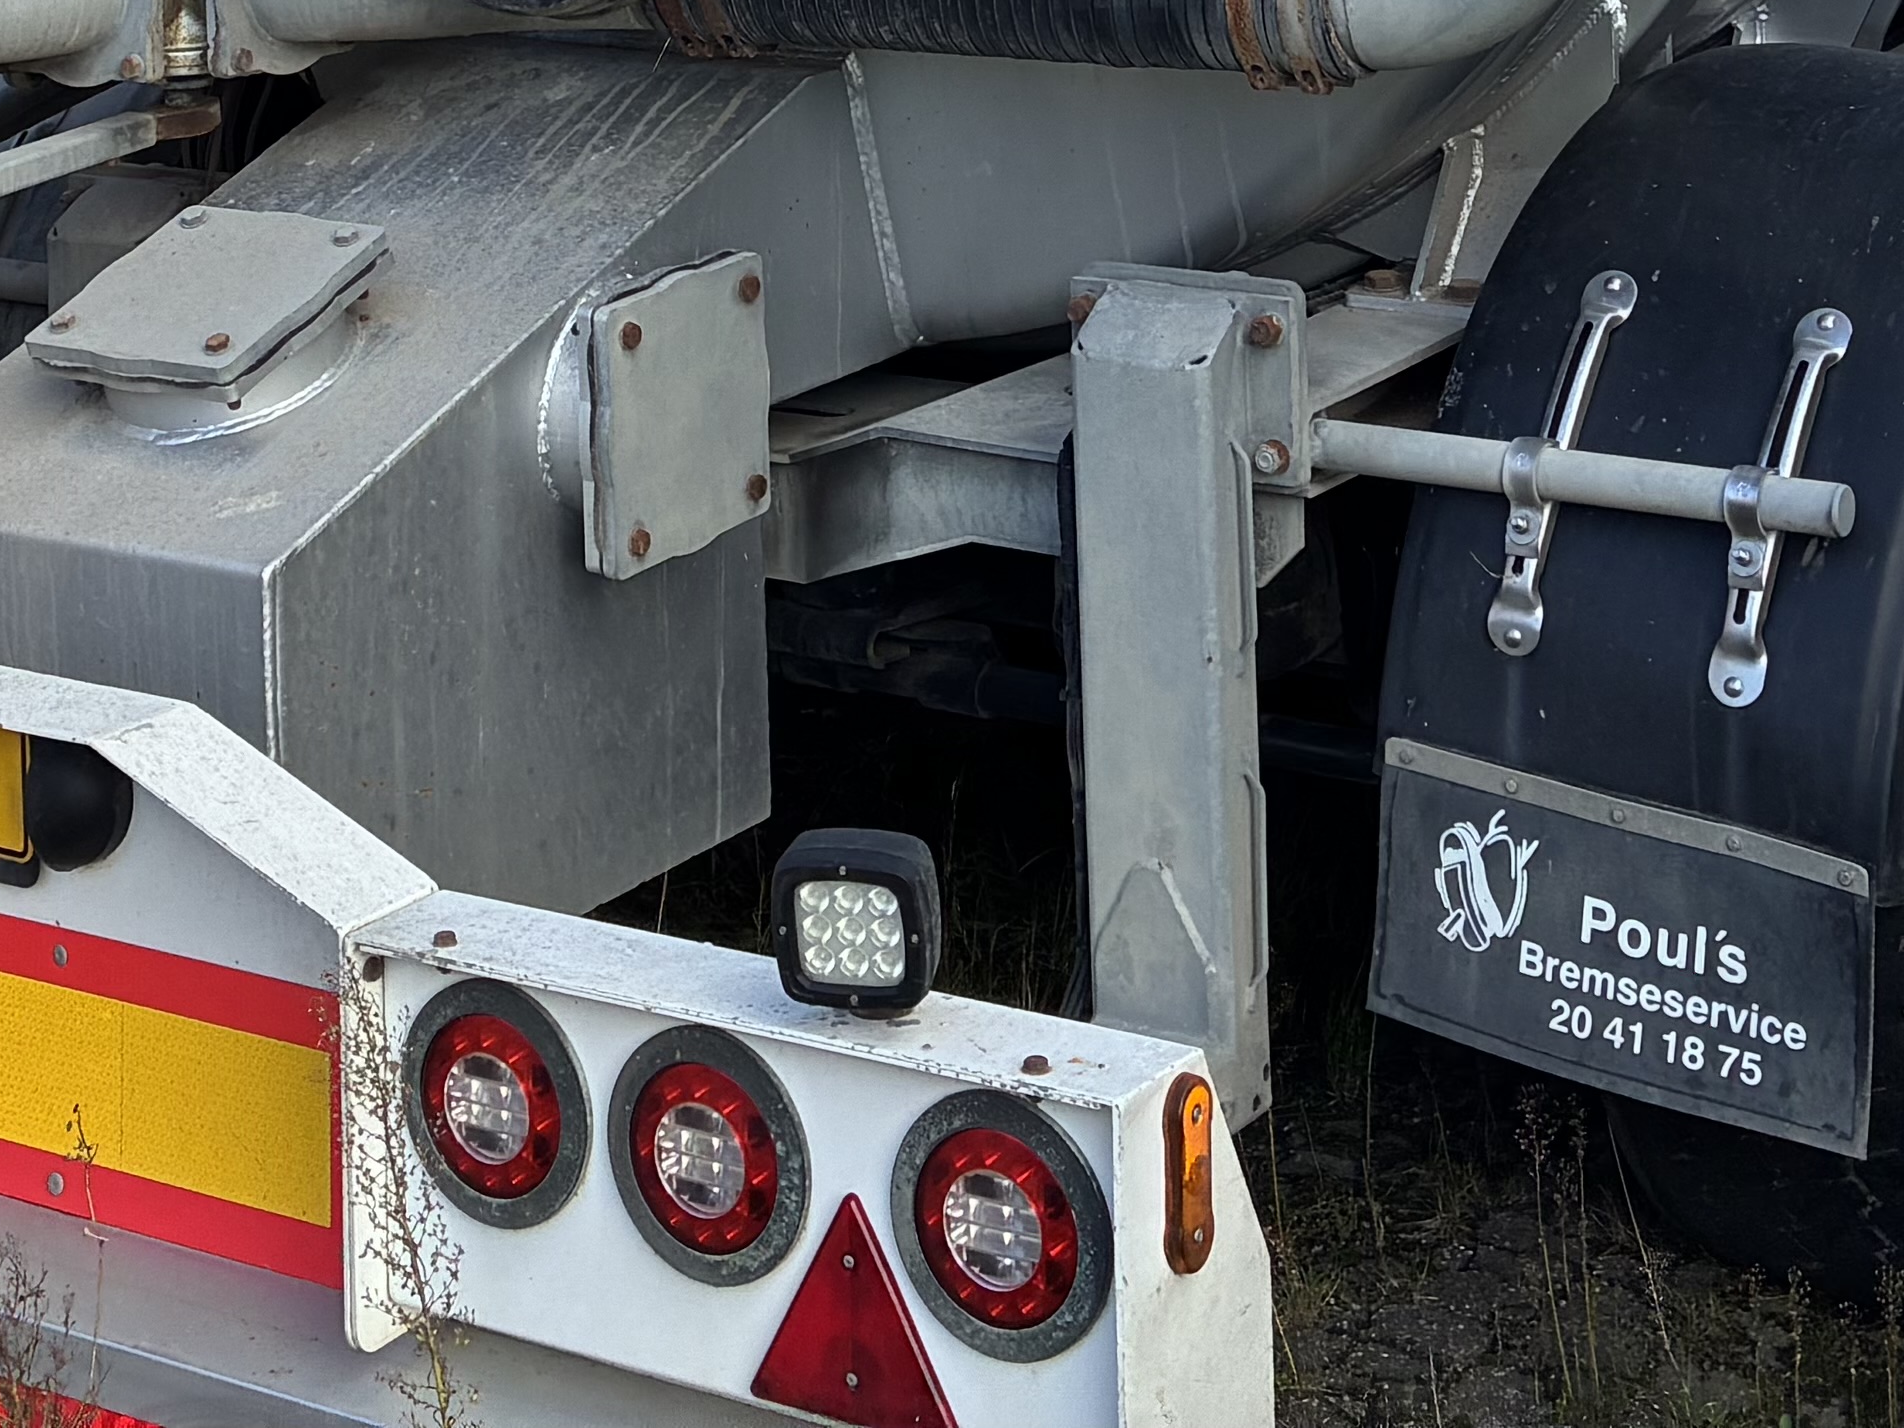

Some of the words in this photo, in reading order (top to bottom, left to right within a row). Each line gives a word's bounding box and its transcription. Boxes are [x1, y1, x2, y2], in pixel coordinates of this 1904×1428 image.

[1518, 940, 1808, 1051] Bremseservice
[1548, 999, 1593, 1040] 20
[1603, 1016, 1644, 1055] 41
[1662, 1031, 1705, 1071] 18
[1718, 1044, 1763, 1086] 75
